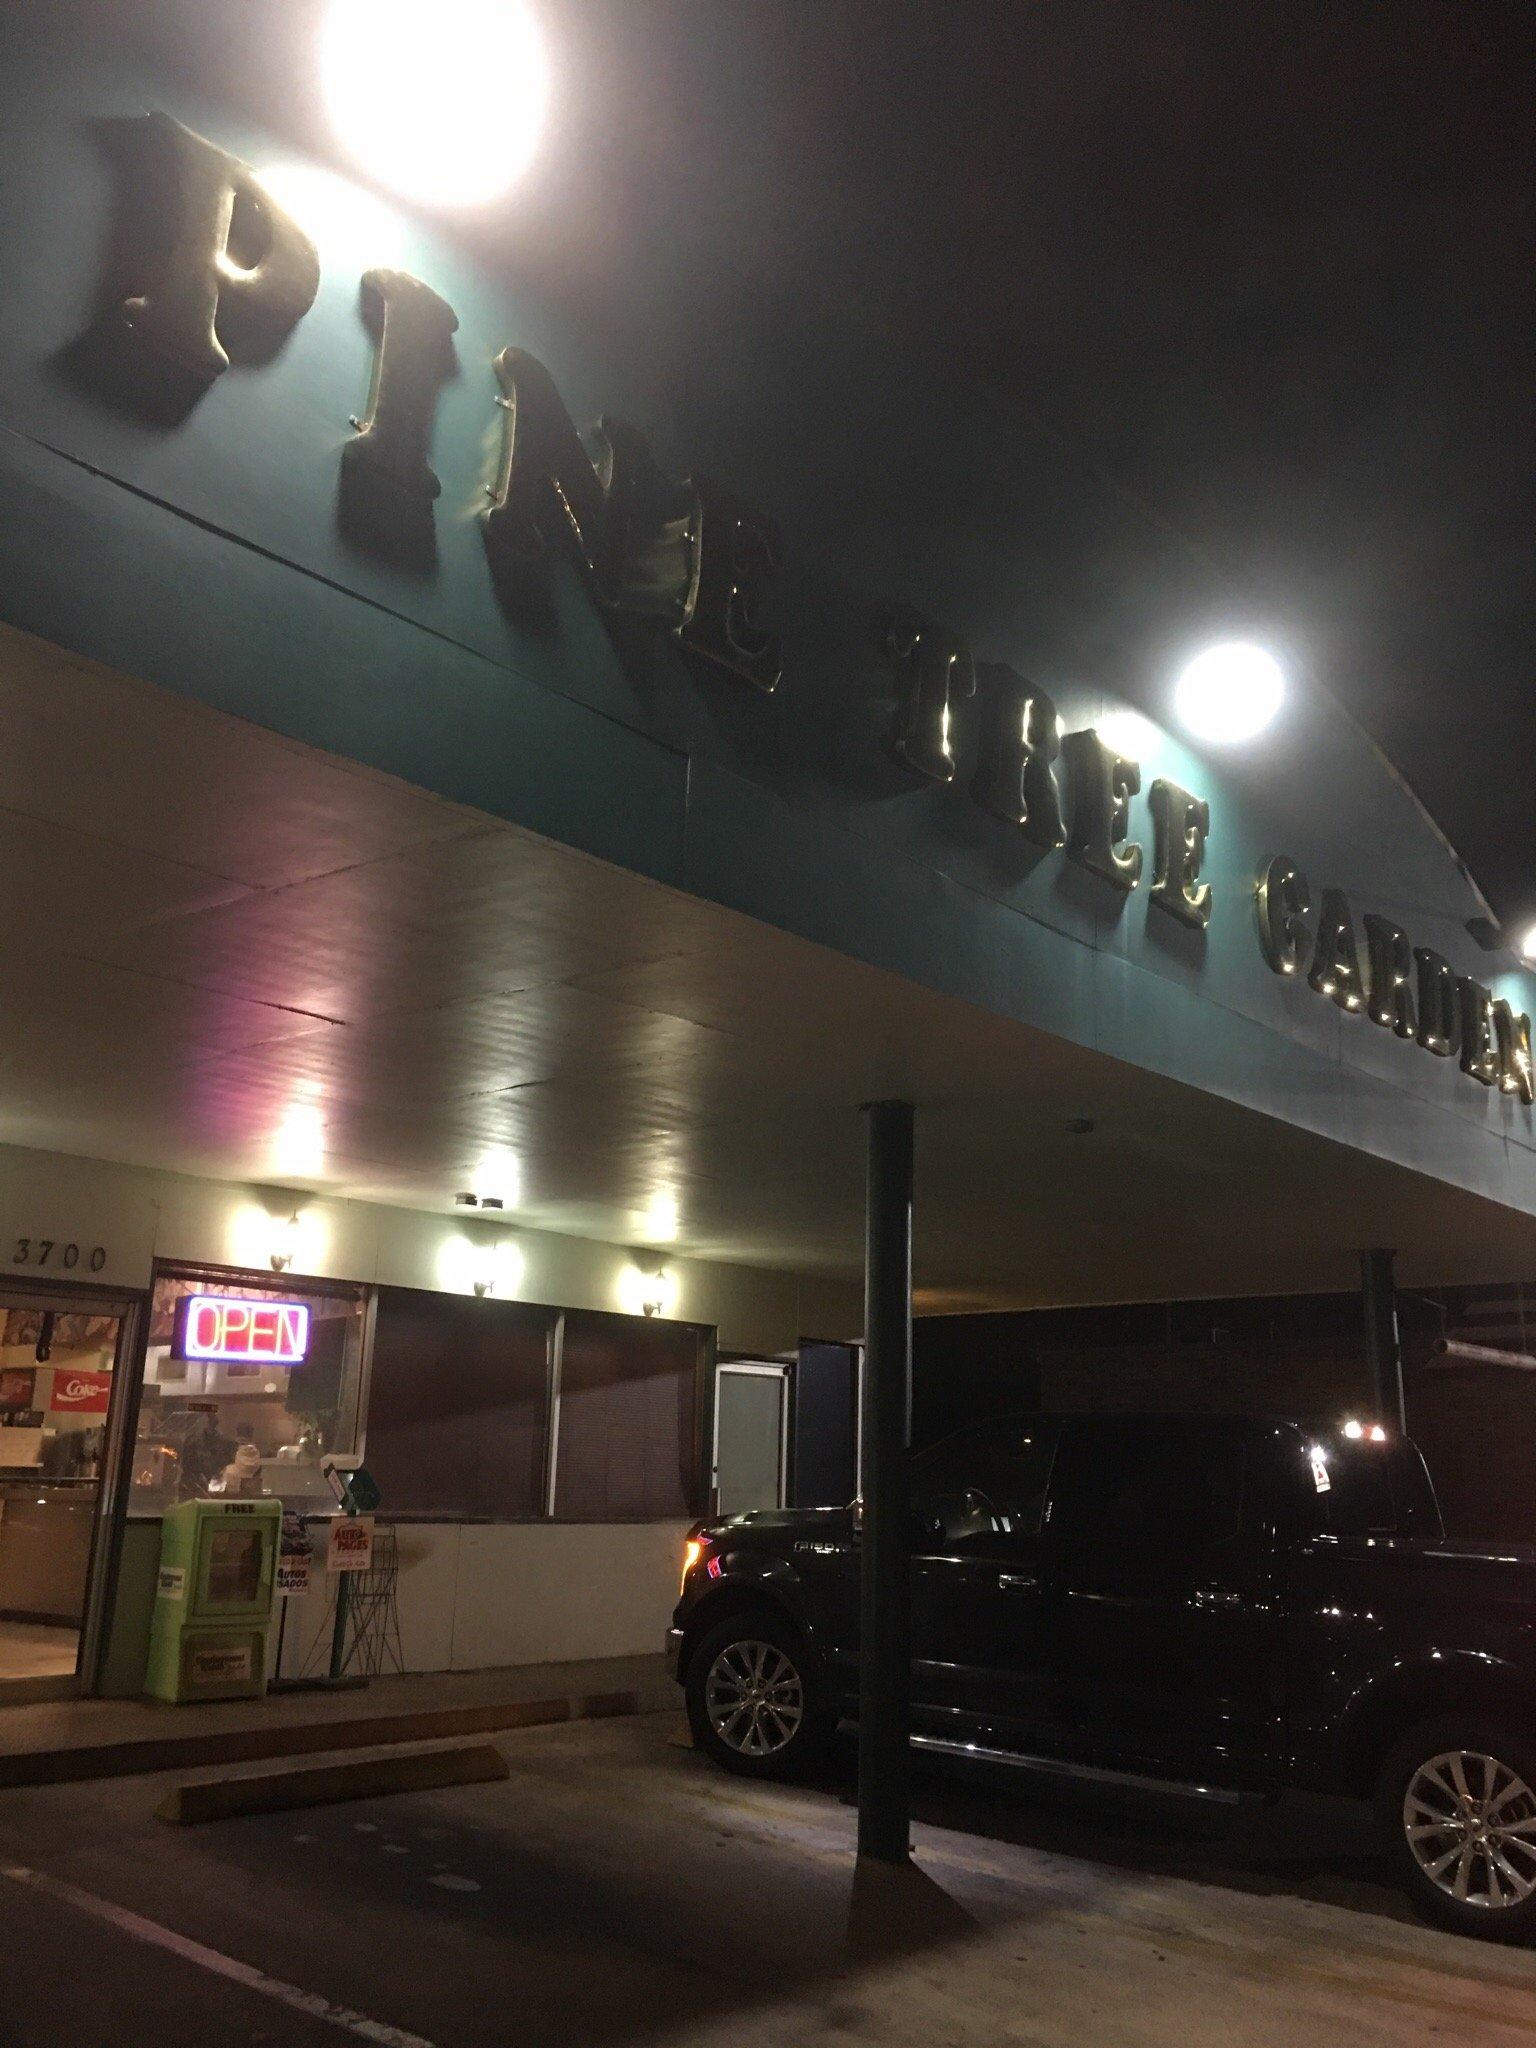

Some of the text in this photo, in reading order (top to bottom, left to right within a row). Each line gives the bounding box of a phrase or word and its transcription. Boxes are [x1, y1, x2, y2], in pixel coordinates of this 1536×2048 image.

[90, 108, 1534, 1106] PINE TREE GARDEN
[12, 1238, 107, 1272] 3700
[190, 1303, 302, 1356] OPEN
[66, 1380, 100, 1397] Coke
[224, 1503, 255, 1514] FREE
